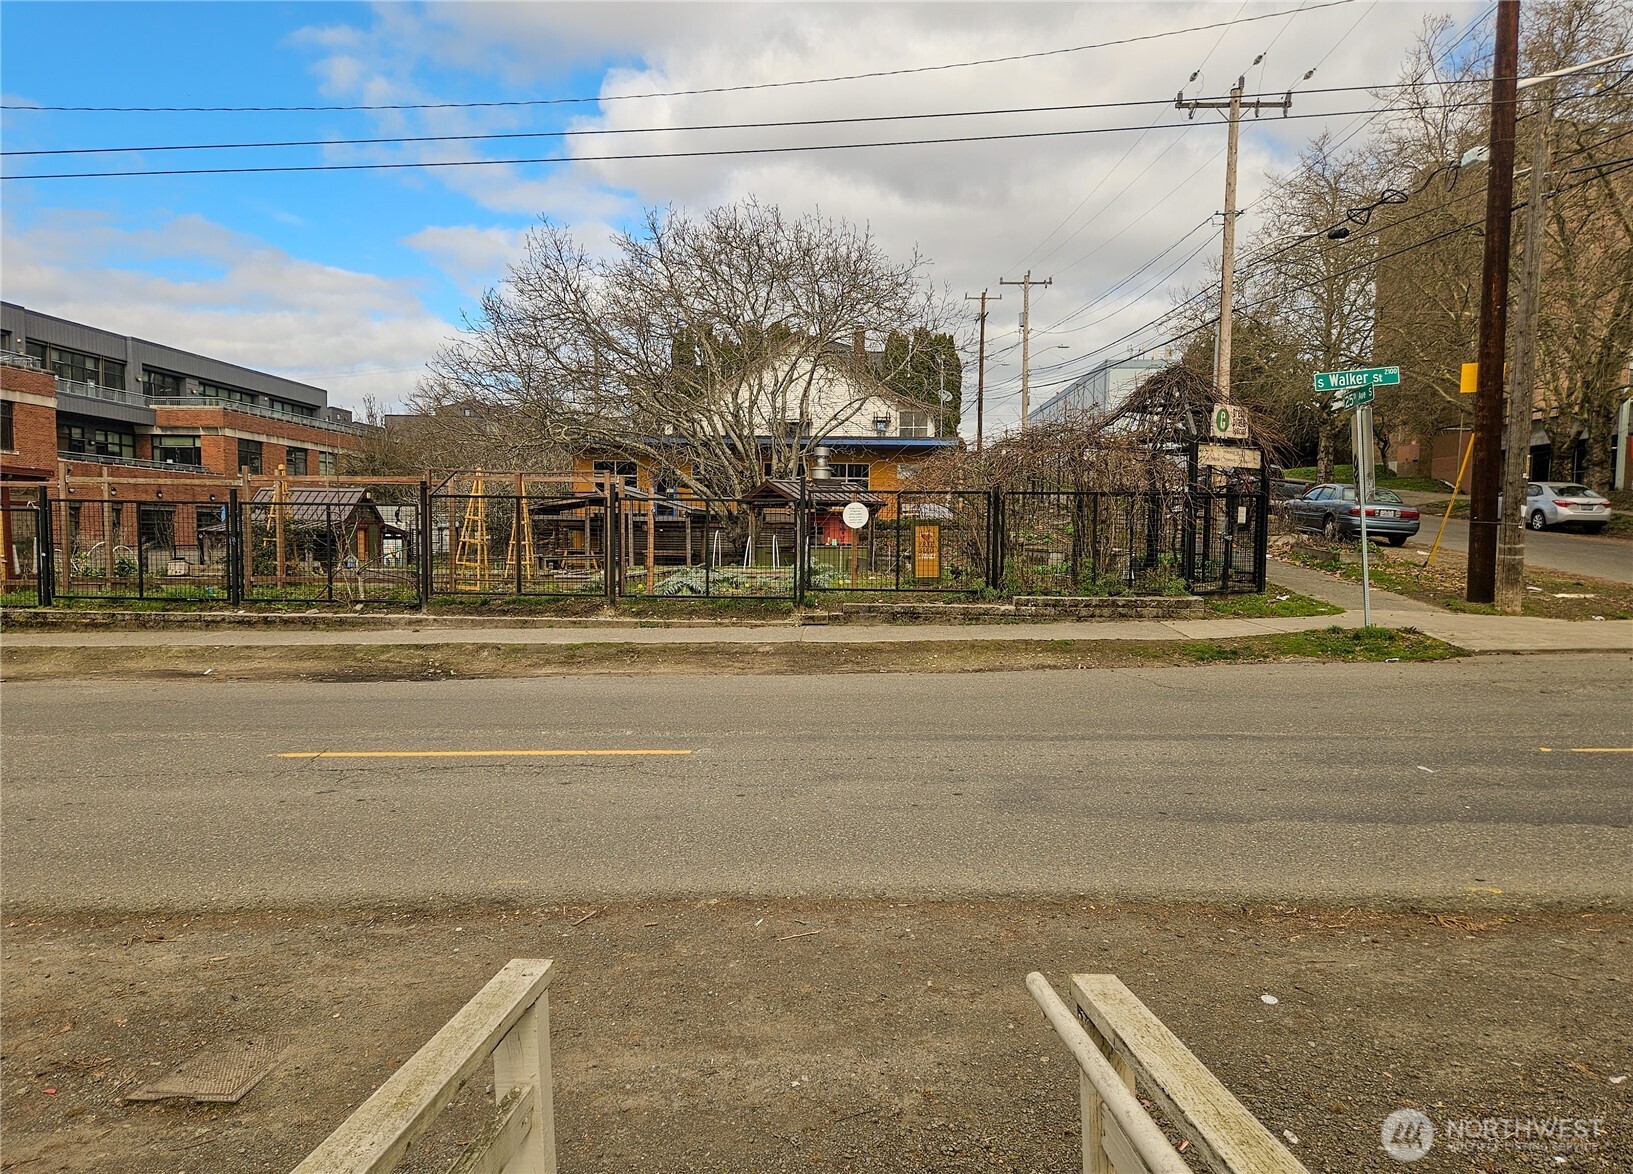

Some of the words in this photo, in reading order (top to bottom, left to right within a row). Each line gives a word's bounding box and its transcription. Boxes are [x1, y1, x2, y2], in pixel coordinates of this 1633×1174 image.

[1317, 379, 1325, 388] S
[1329, 373, 1368, 387] Walker
[1372, 373, 1383, 383] St
[1368, 387, 1373, 397] S
